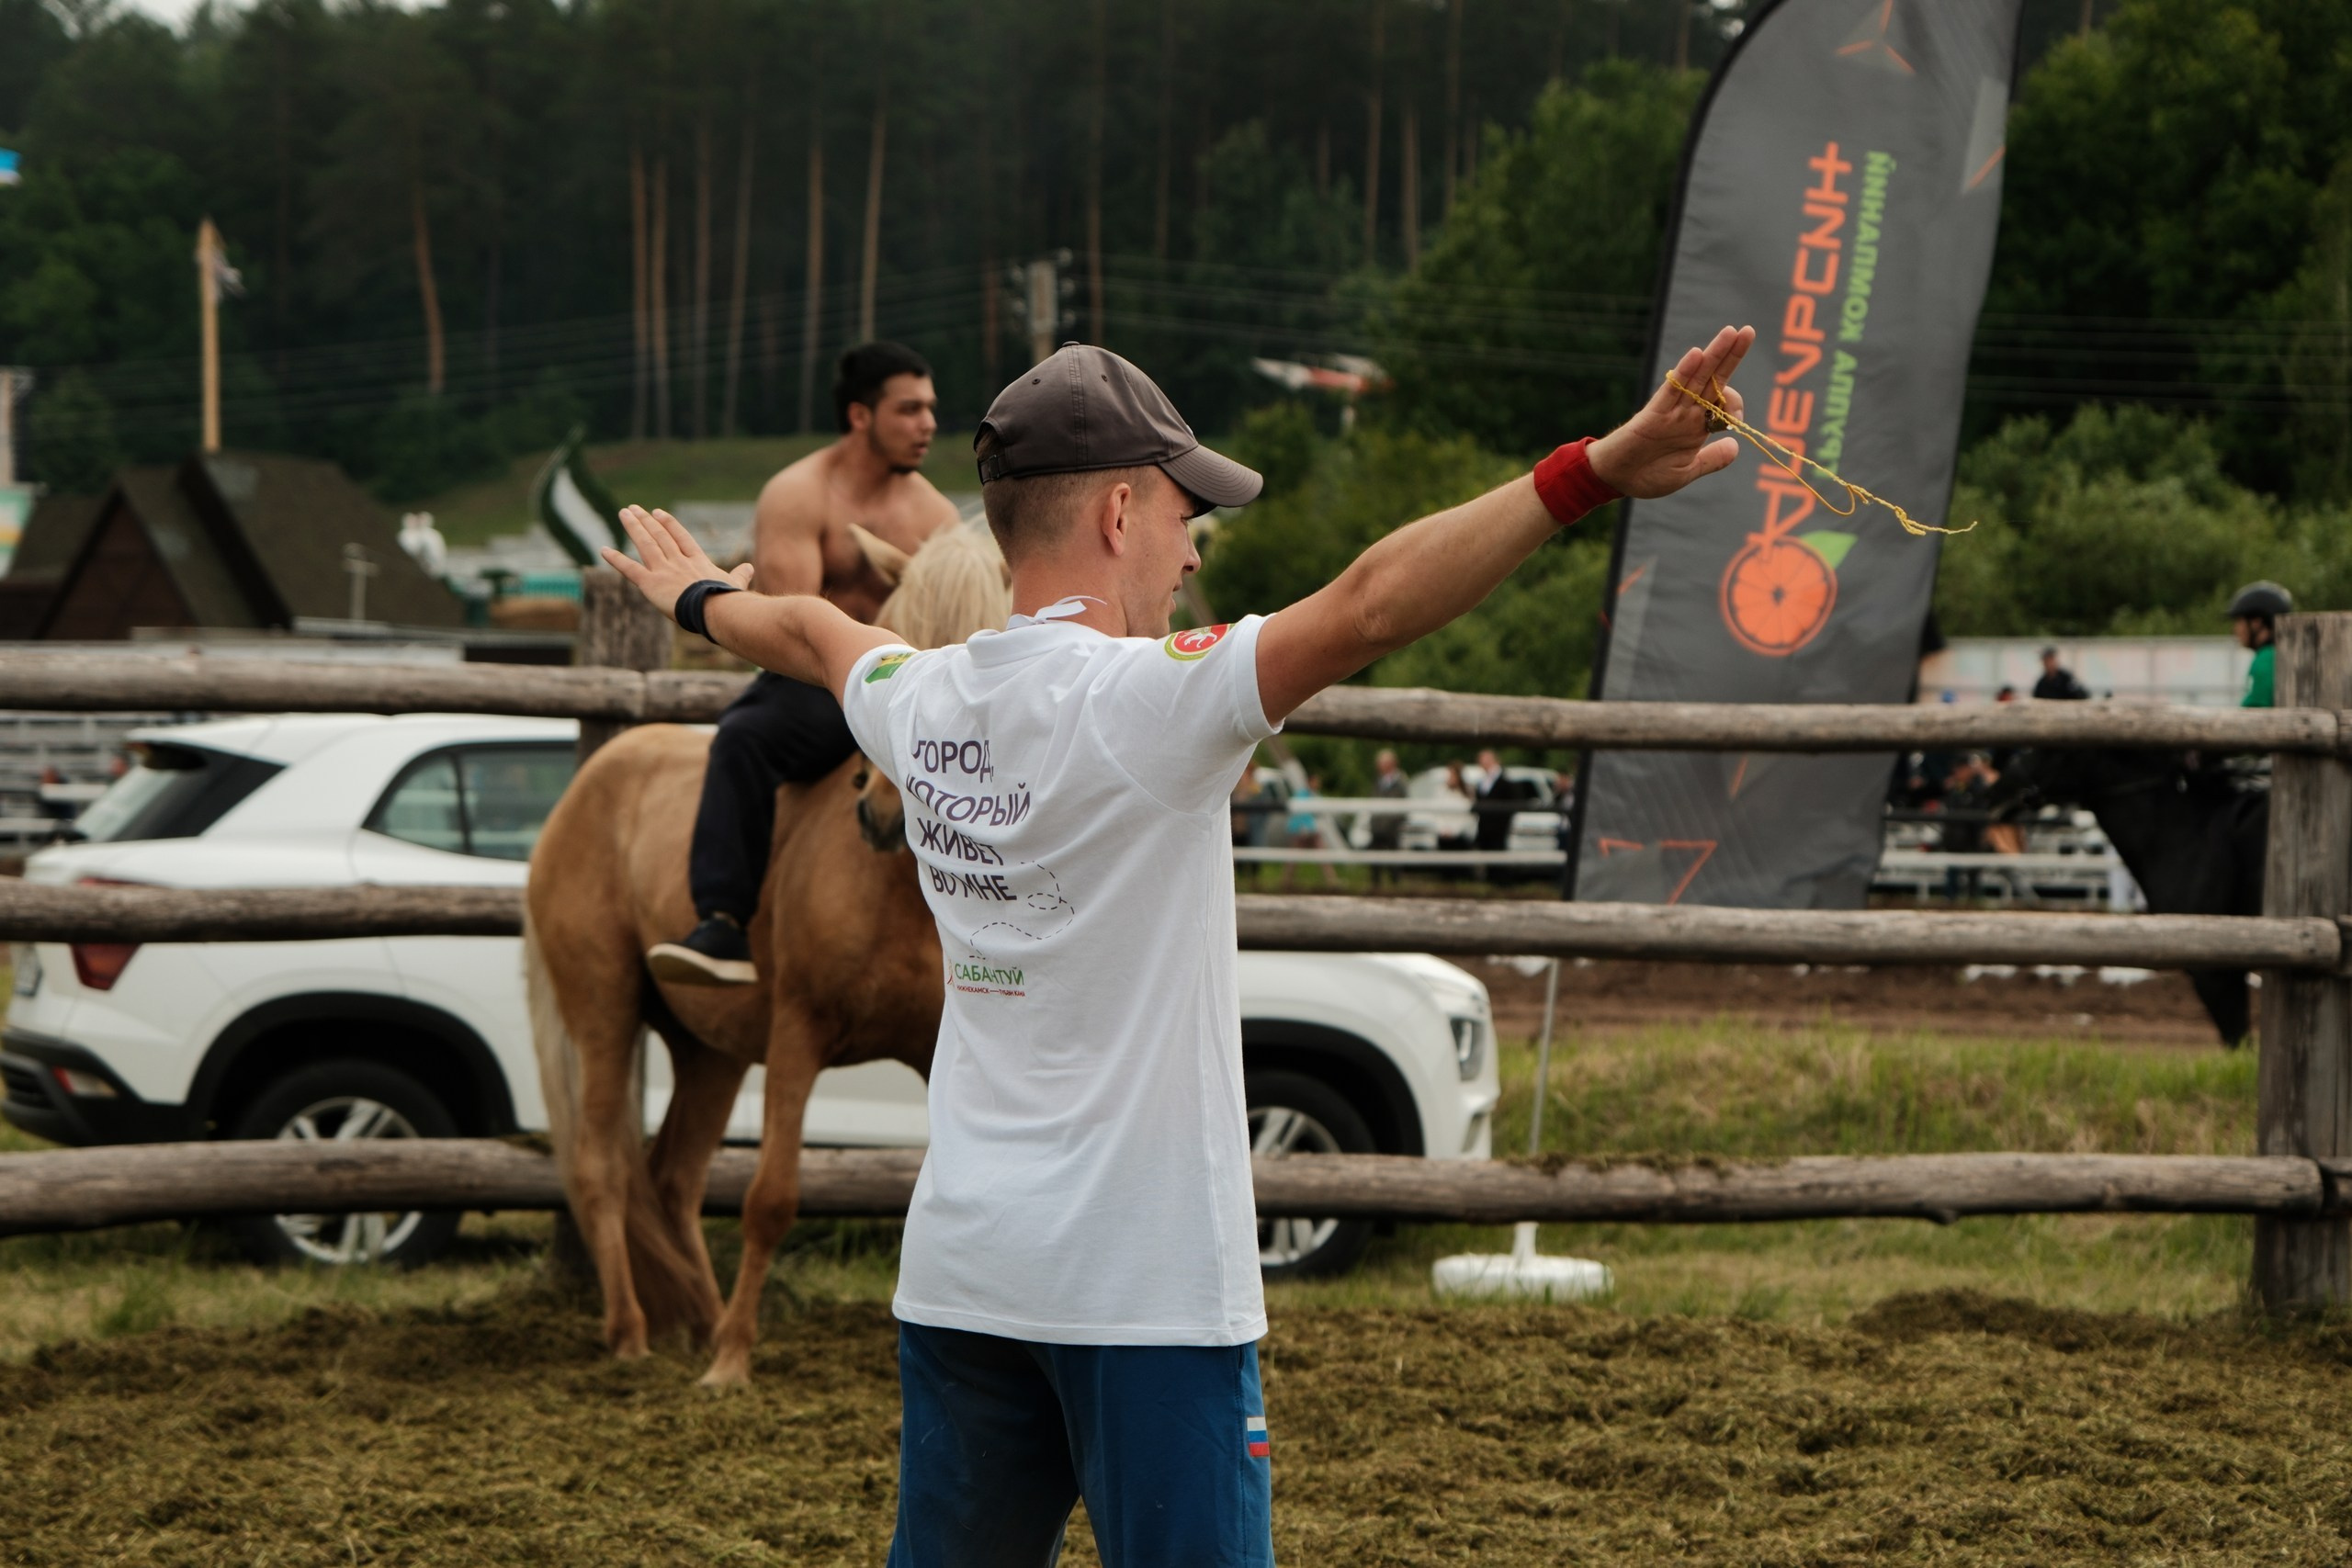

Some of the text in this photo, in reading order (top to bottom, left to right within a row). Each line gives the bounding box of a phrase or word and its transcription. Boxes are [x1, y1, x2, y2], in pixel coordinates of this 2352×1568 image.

[929, 864, 1017, 901] ВО МНЕ
[954, 963, 1024, 986] САБАНТУЙ
